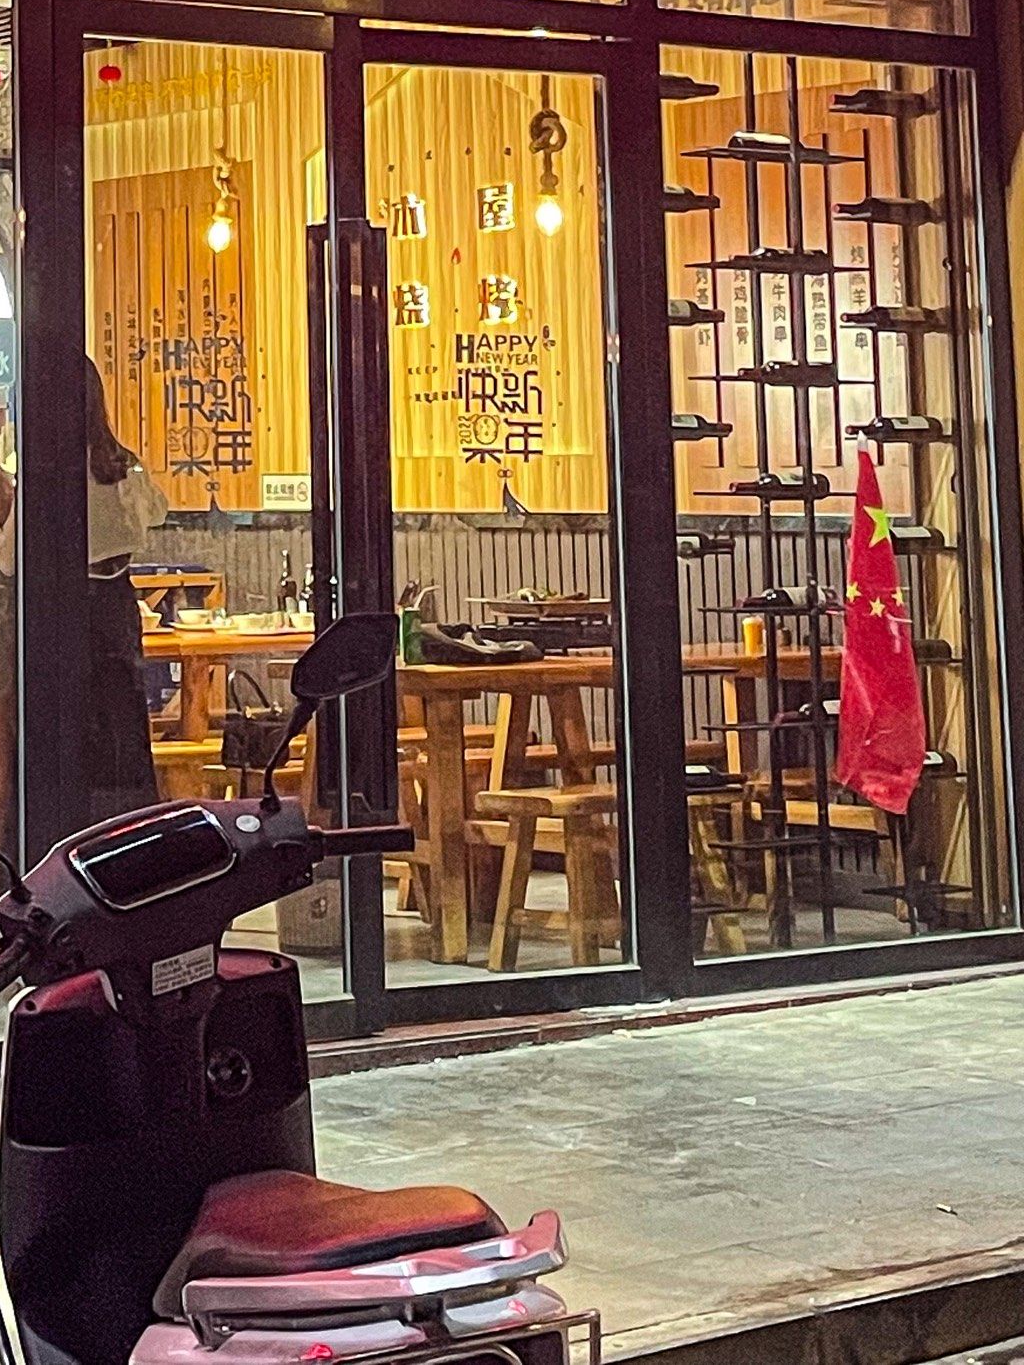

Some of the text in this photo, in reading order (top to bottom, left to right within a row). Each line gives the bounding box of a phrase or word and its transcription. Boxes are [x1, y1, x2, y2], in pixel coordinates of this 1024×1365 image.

[771, 276, 787, 342] 牛肉串
[455, 333, 538, 364] HAPPY
[476, 352, 539, 366] NEW YEAR
